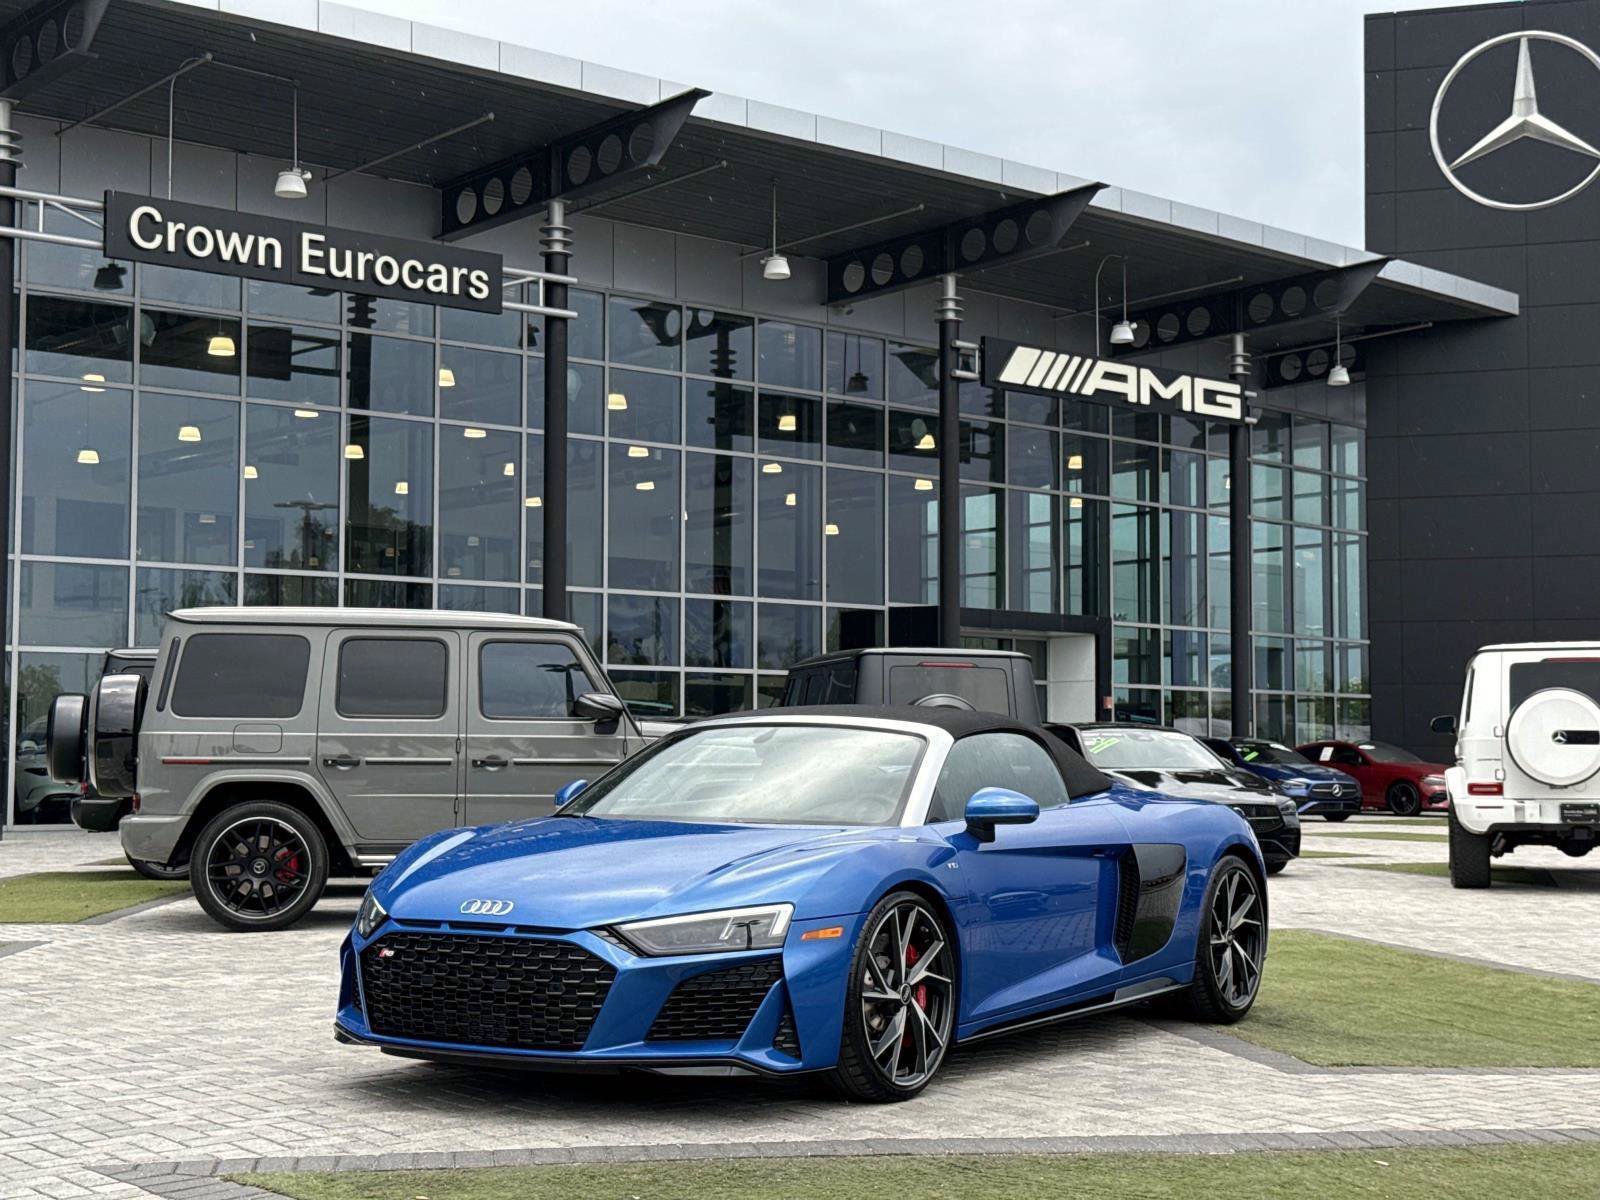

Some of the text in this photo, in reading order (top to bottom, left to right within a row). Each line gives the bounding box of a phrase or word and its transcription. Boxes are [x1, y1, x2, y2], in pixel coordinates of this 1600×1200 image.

[129, 205, 490, 300] Crown Eurocars
[1081, 360, 1241, 420] AMG
